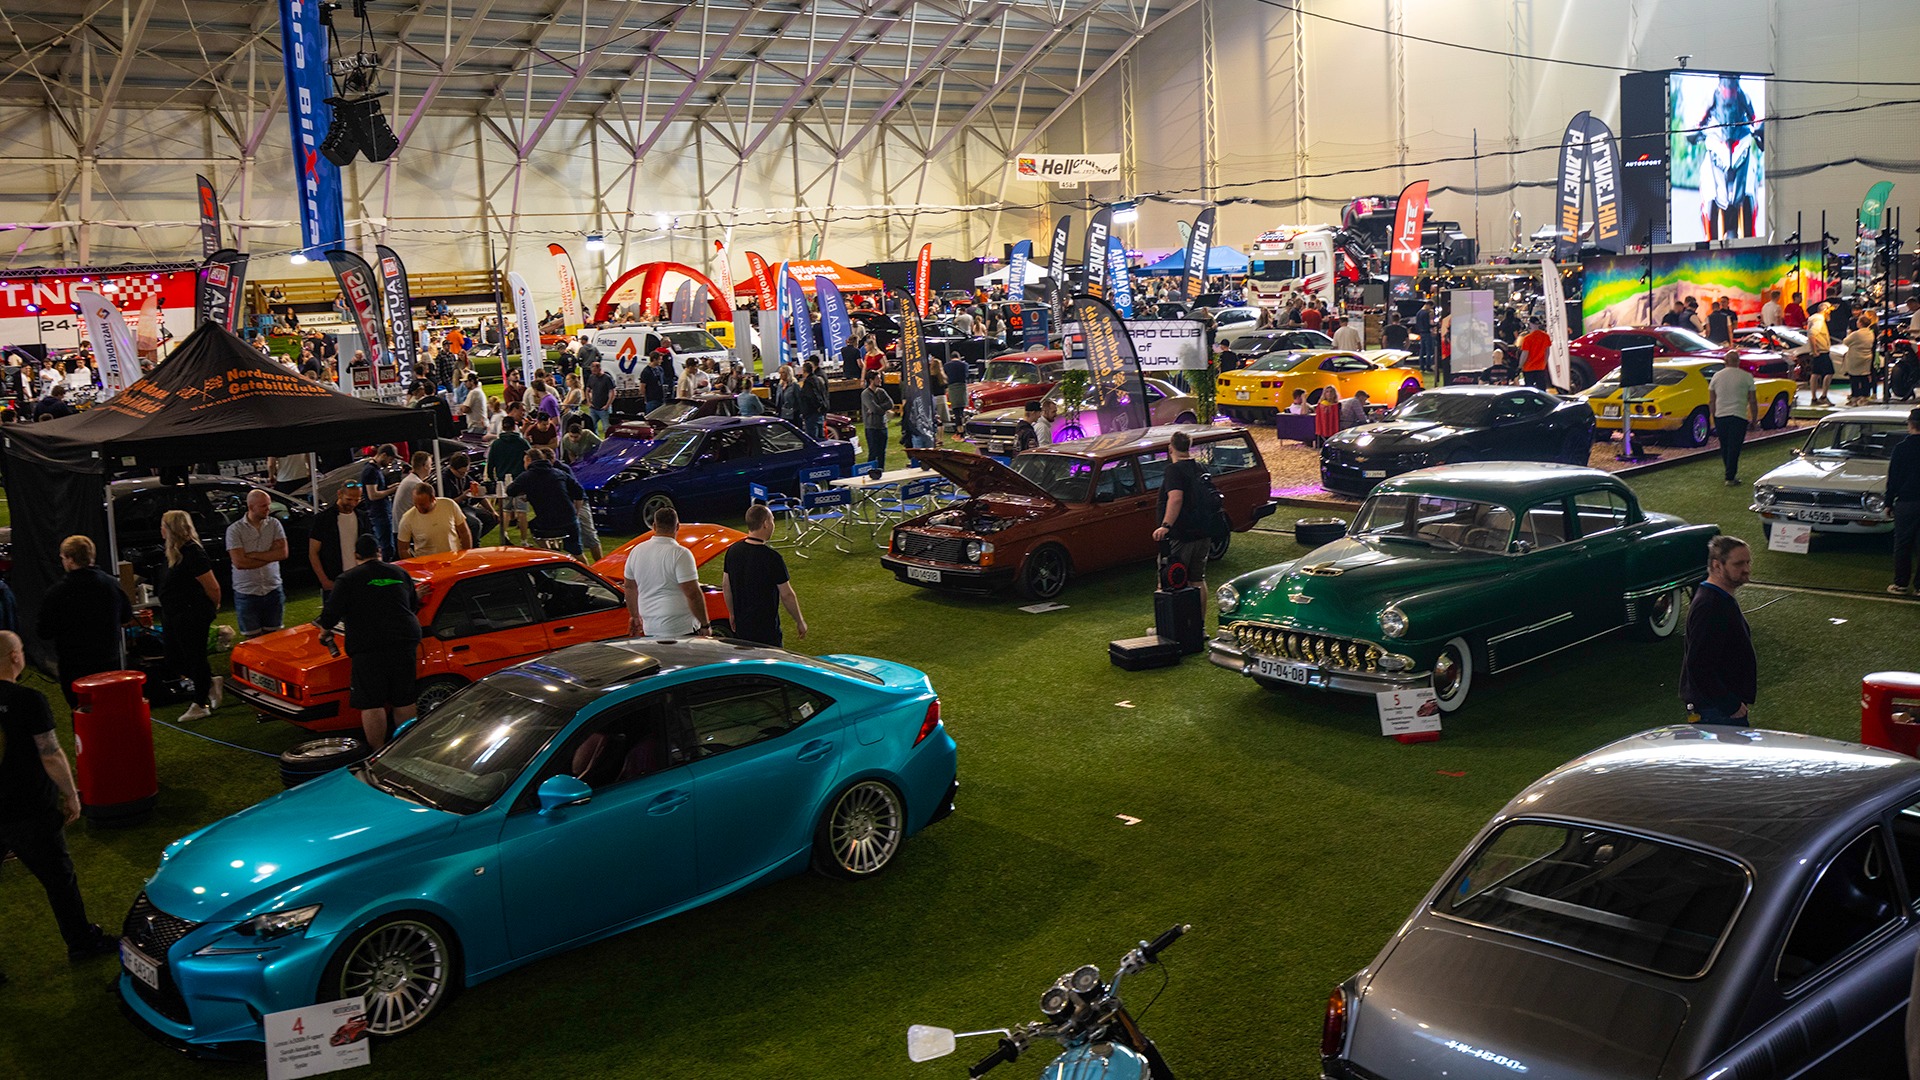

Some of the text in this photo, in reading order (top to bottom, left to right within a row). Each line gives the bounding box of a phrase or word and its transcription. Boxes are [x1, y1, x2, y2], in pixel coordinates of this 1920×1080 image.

[290, 0, 306, 70] tra
[298, 86, 320, 246] BilXtra
[1041, 158, 1118, 175] Hell Cruisers
[1625, 159, 1662, 167] AUTOSPORT
[1562, 128, 1584, 243] PLANET HIFI
[1398, 198, 1419, 262] VIBE
[1088, 222, 1108, 286] PLANET
[1189, 221, 1210, 280] PLANET
[788, 264, 835, 274] Bilpleie
[1009, 253, 1024, 295] YAMAHA
[201, 286, 211, 324] PASSIO
[209, 288, 226, 325] AU
[1160, 329, 1201, 338] CLUB
[1138, 342, 1152, 352] of
[226, 367, 298, 383] Nordmøre
[228, 379, 327, 395] GatebilKlubb
[814, 494, 841, 504] sparco
[1780, 526, 1787, 535] 6
[1260, 661, 1305, 682] 97-04-08
[1393, 694, 1401, 706] 5
[292, 1016, 305, 1035] 4
